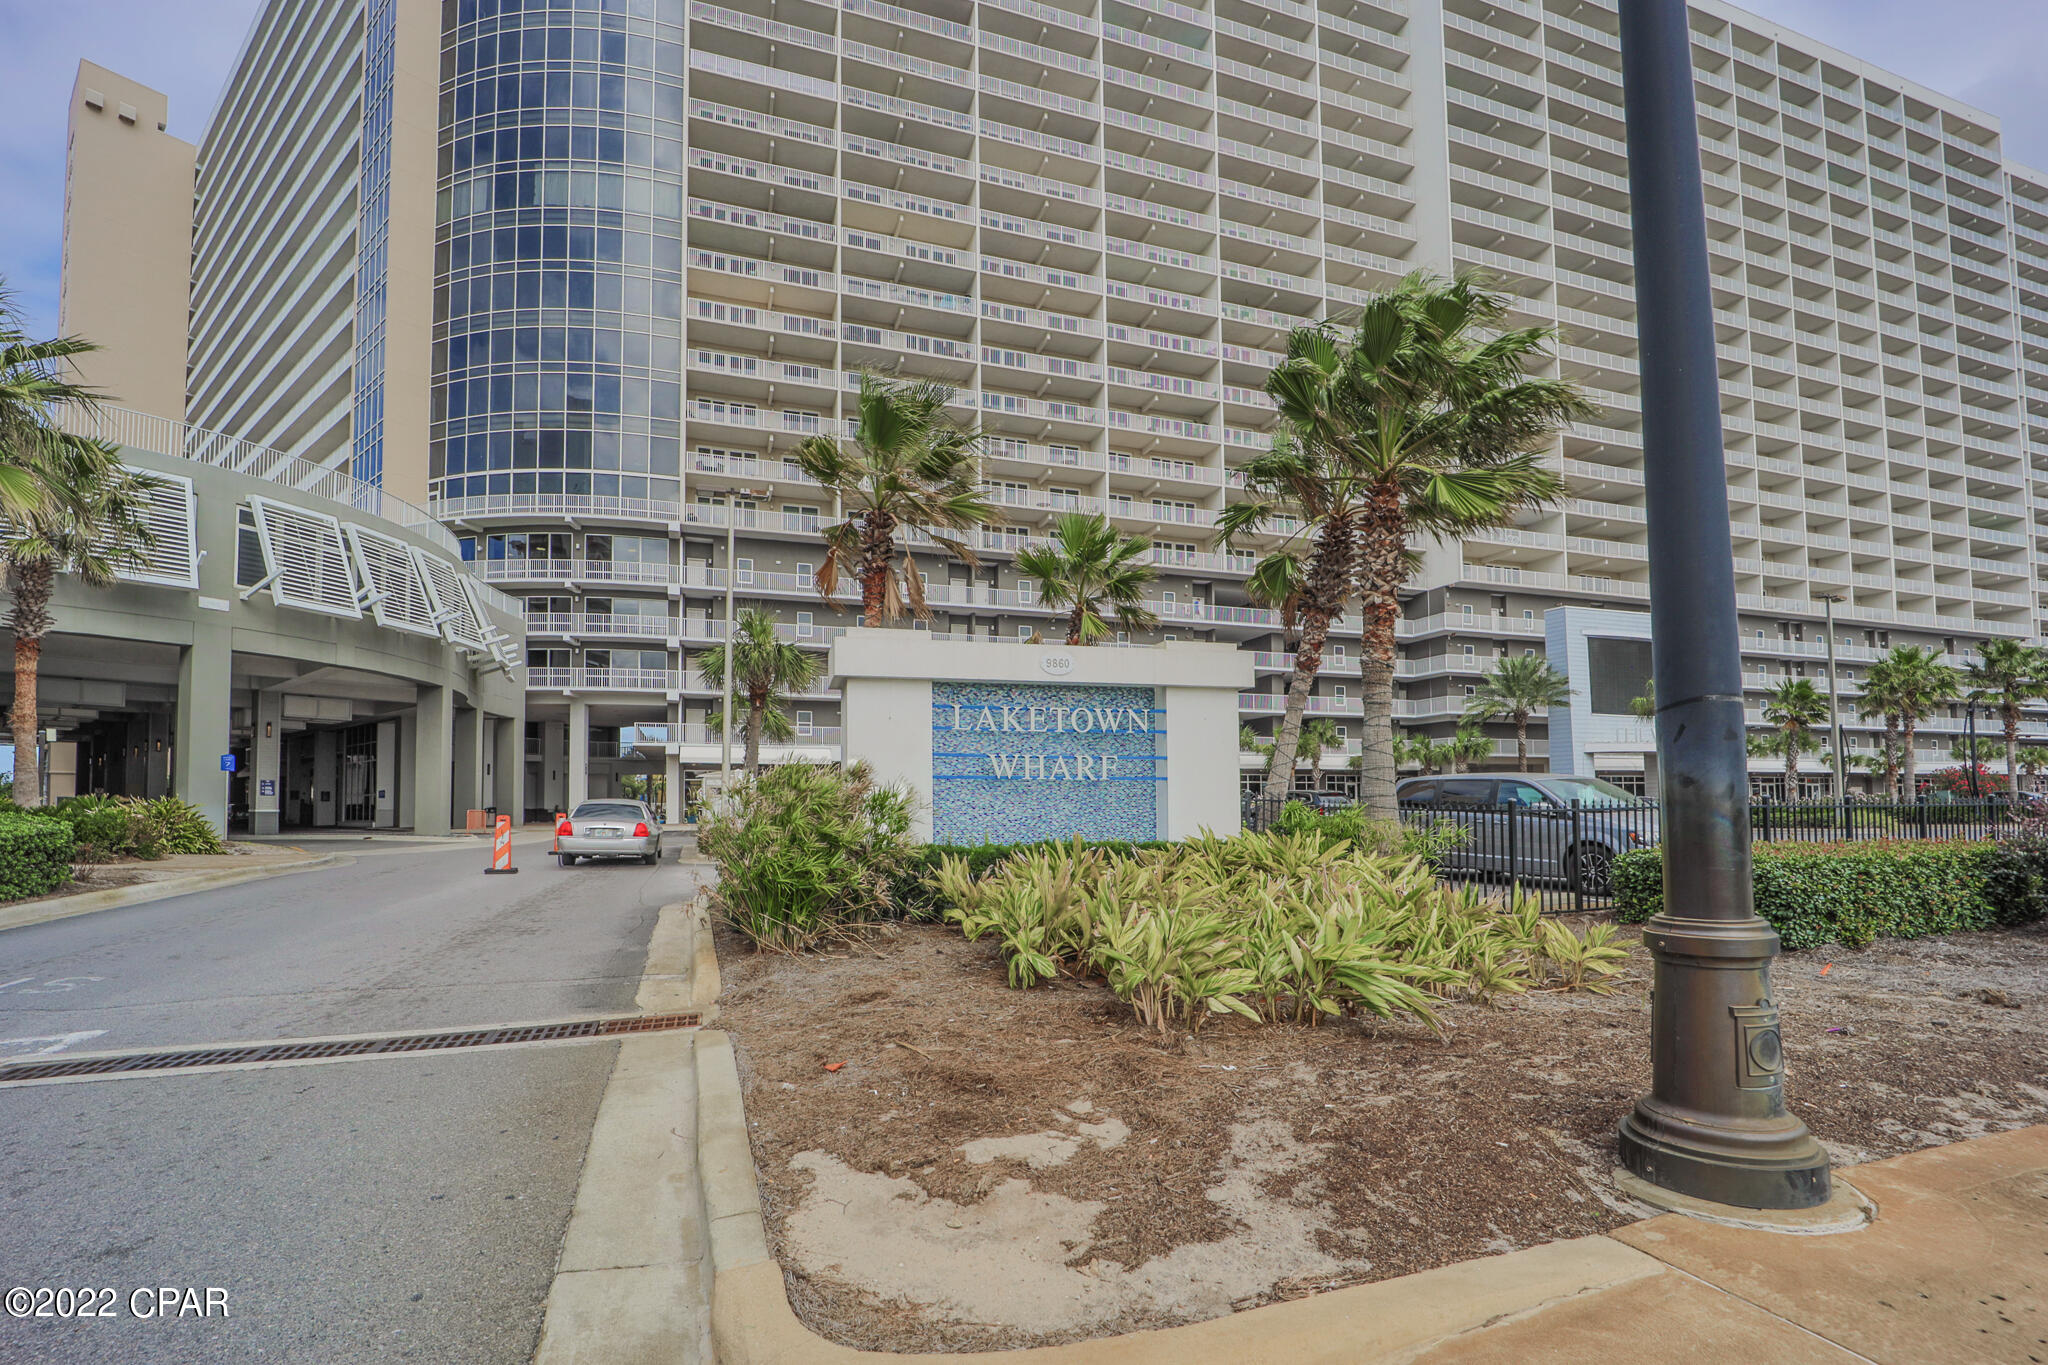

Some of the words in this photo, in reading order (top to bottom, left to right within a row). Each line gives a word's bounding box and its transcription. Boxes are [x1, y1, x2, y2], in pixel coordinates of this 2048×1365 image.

[1046, 658, 1070, 669] 9860
[951, 704, 1150, 733] LAKETOWN
[987, 753, 1118, 781] WHARF
